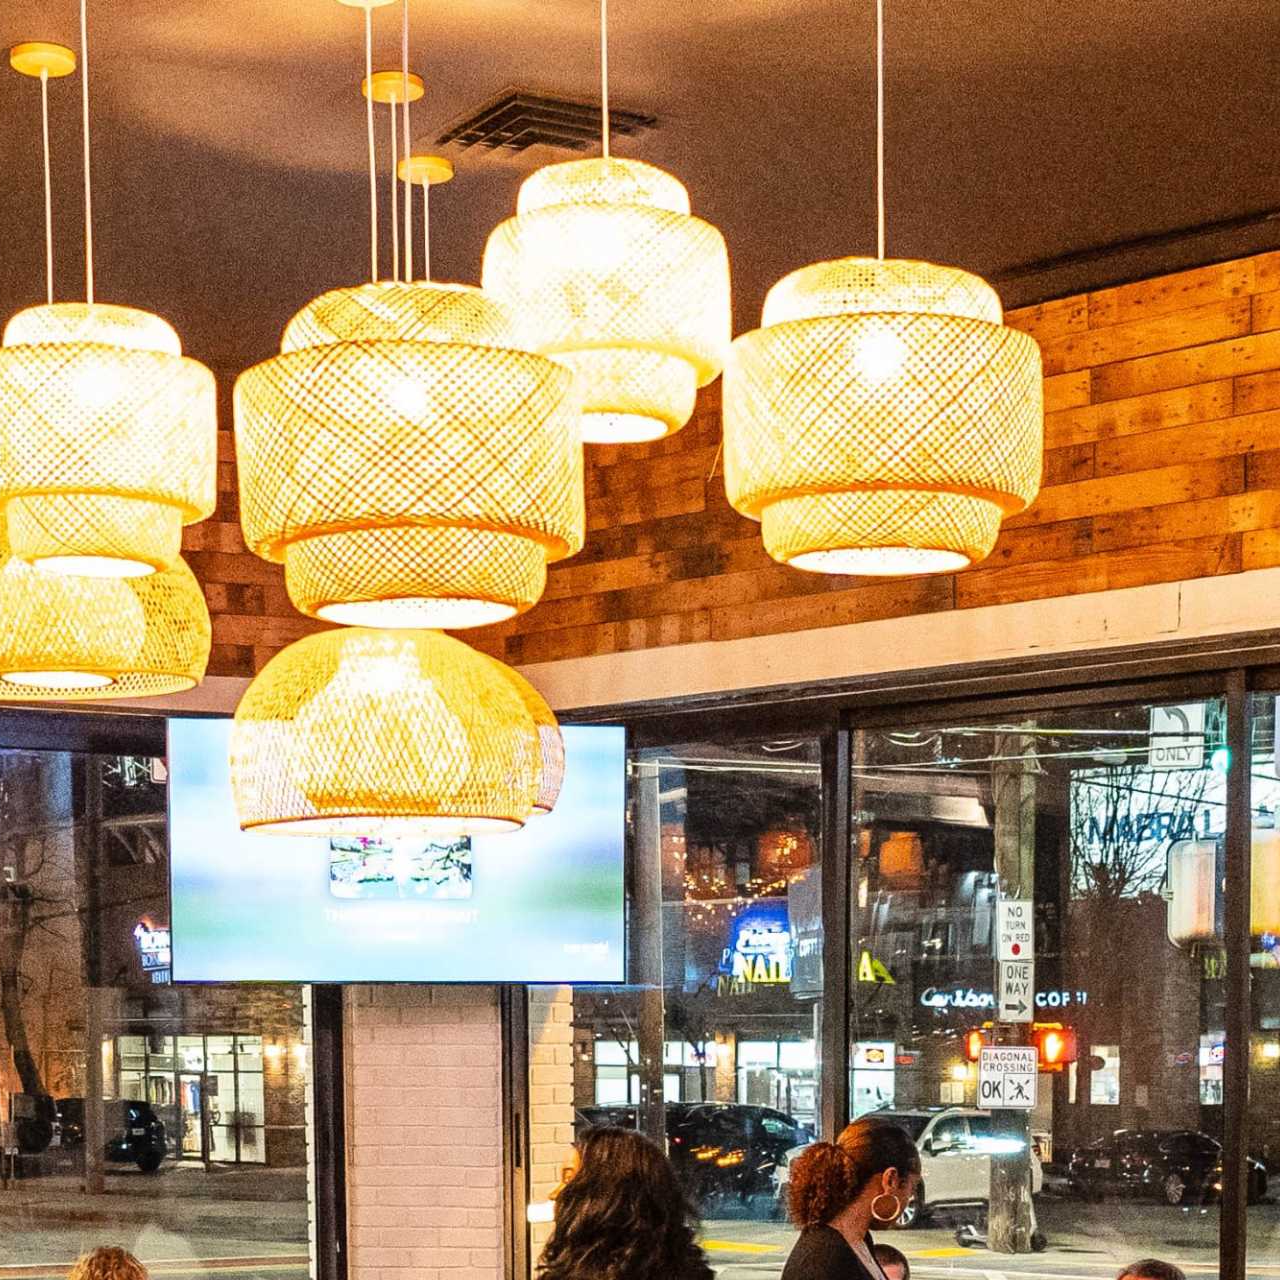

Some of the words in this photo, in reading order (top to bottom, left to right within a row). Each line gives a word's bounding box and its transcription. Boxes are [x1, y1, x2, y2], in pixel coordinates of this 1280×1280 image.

[1156, 747, 1193, 761] ONLY
[1007, 906, 1023, 918] NO
[1006, 921, 1026, 930] TURN
[1002, 934, 1012, 942] ON
[1015, 934, 1030, 943] RED
[1006, 965, 1029, 980] ONE
[1005, 982, 1029, 996] WAY
[982, 1052, 1033, 1061] DIAGONAL
[983, 1063, 1033, 1072] CROSSING
[981, 1080, 1001, 1099] OK
